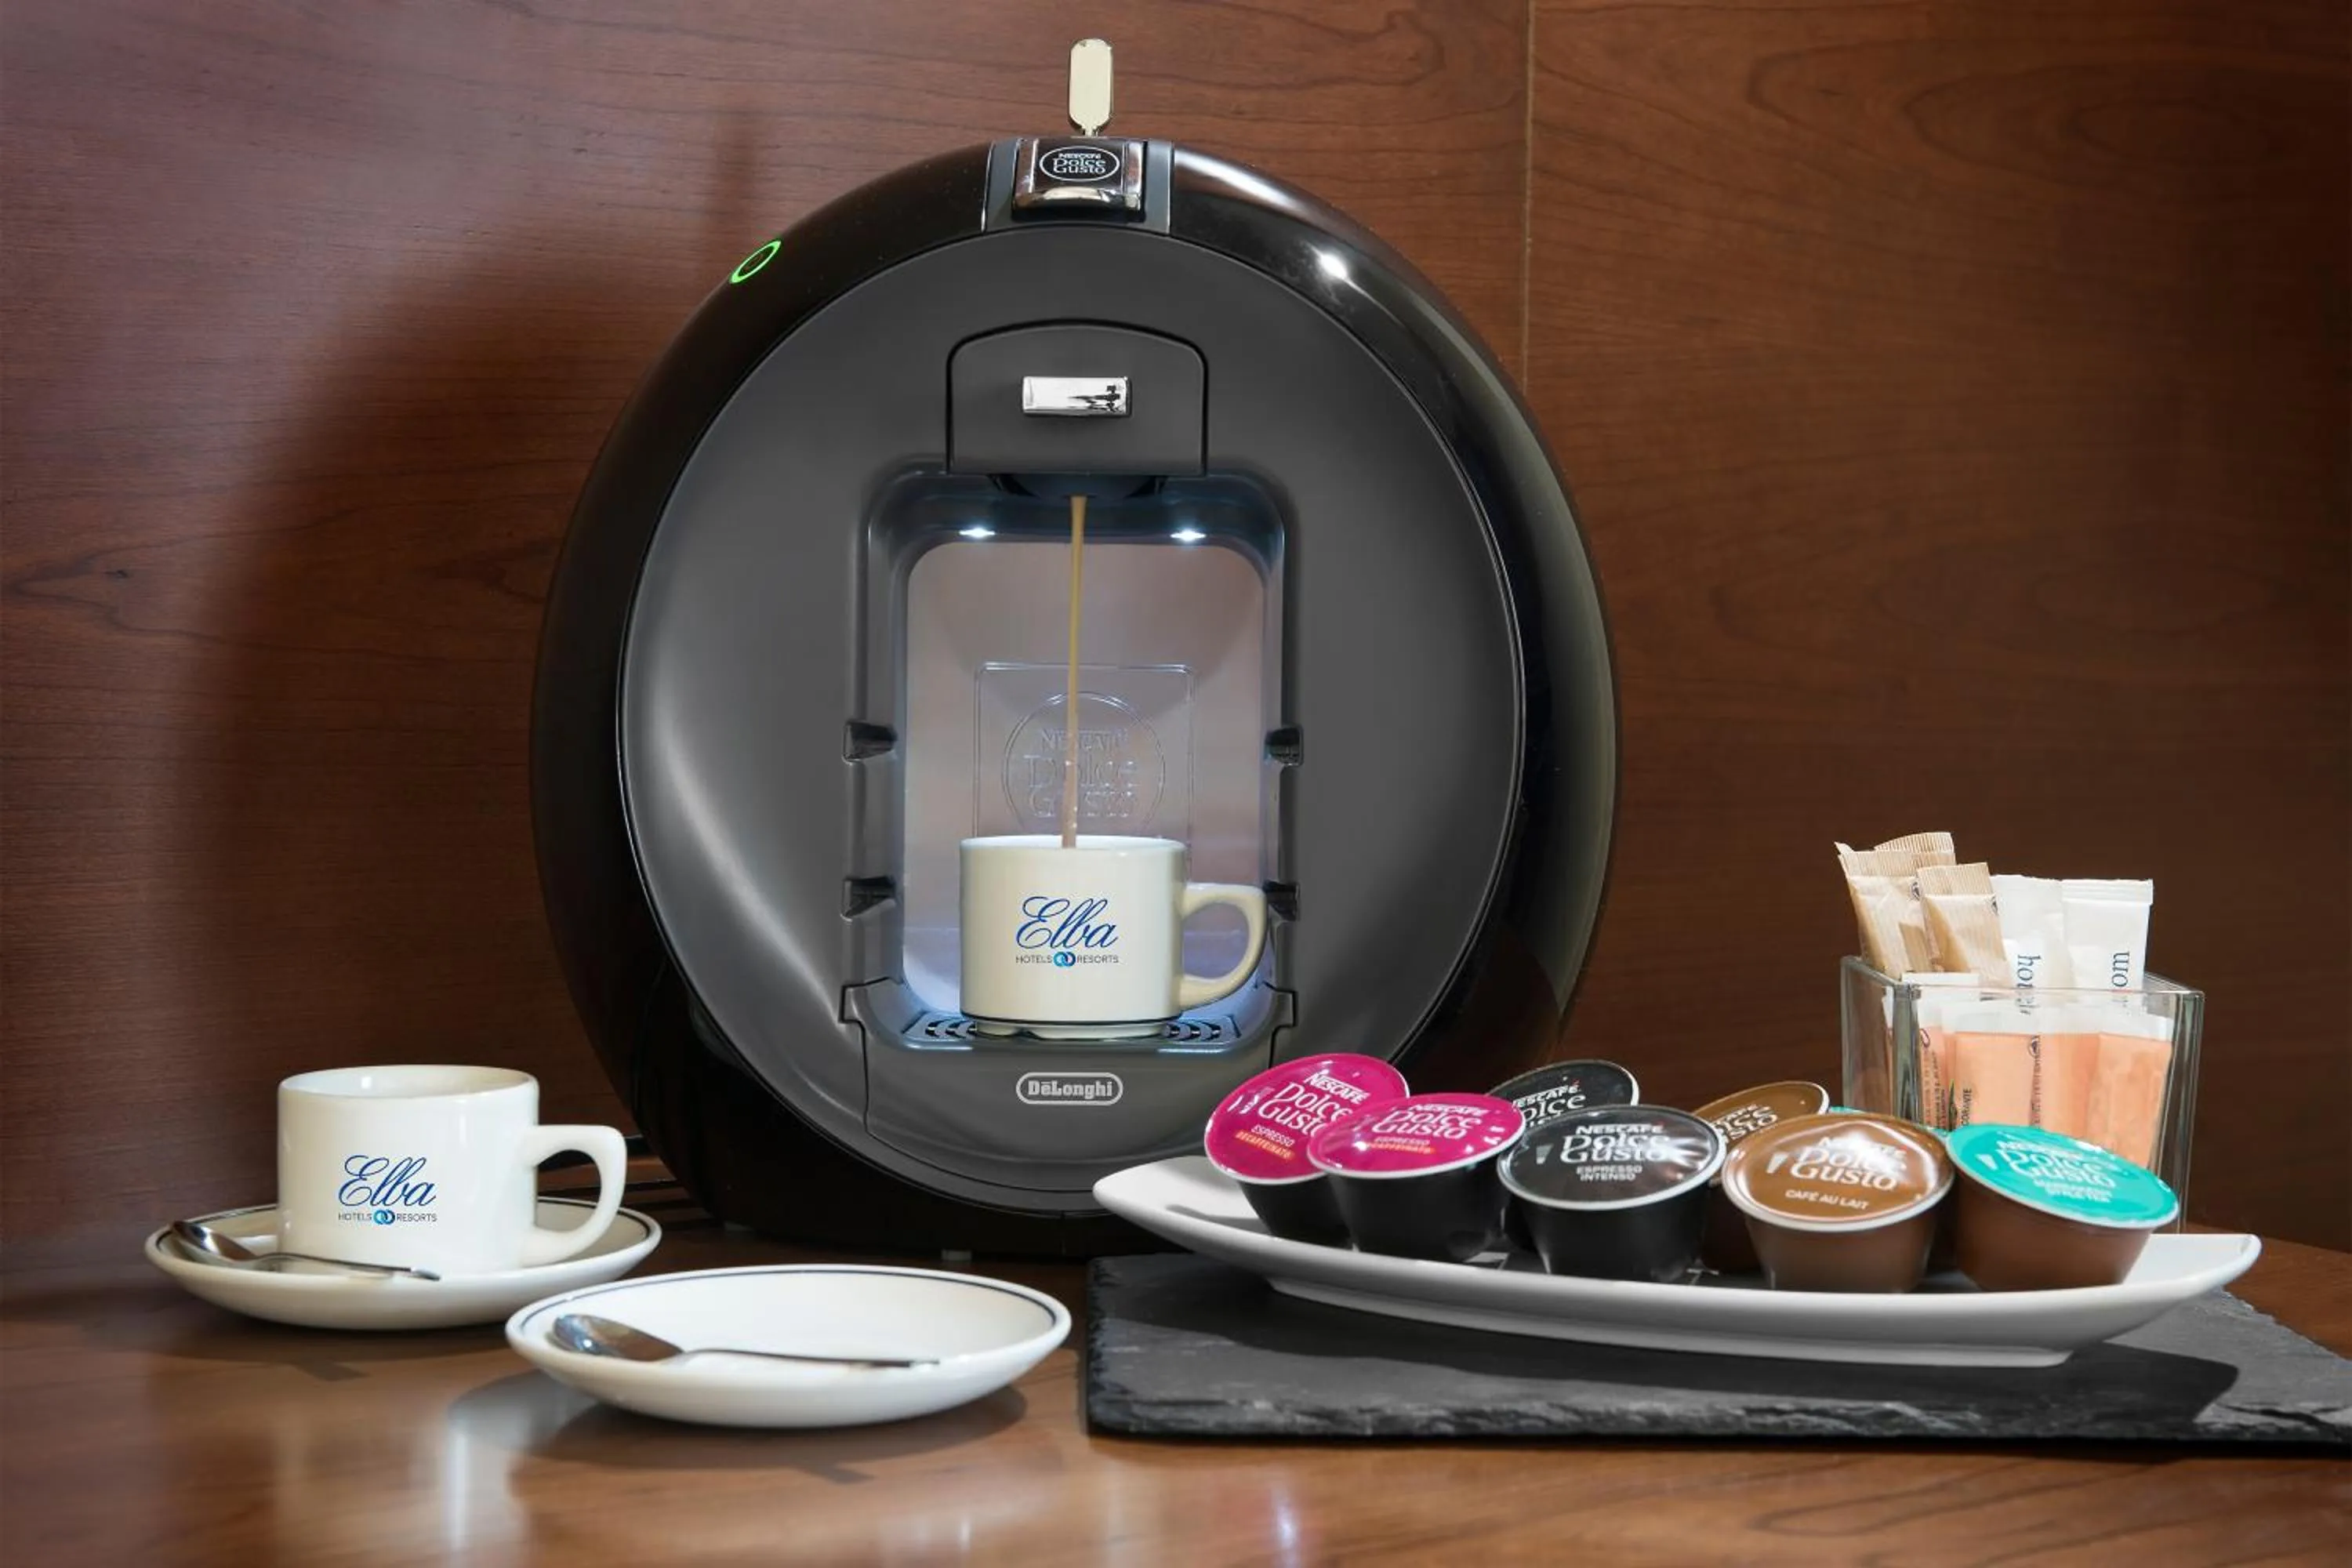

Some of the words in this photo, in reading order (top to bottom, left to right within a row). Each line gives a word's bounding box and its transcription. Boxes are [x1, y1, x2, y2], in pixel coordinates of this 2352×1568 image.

[1016, 896, 1119, 949] Elba
[1016, 954, 1053, 964] HOTELS
[1076, 954, 1120, 964] RESORTS
[1274, 1082, 1354, 1122] Dolce
[1383, 1109, 1483, 1129] Dolce
[1372, 1122, 1468, 1139] Gusto
[1563, 1132, 1670, 1151] Dolce
[1559, 1148, 1668, 1163] Gusto
[1576, 1165, 1643, 1174] ESPRESSO
[1580, 1173, 1637, 1182] INTENSO
[1790, 1162, 1897, 1192] Gusto
[338, 1154, 437, 1207] Elba
[1819, 1194, 1838, 1205] AU
[1838, 1197, 1869, 1210] LAIT
[338, 1213, 372, 1221] HOTELS
[397, 1213, 438, 1222] RESORTS
